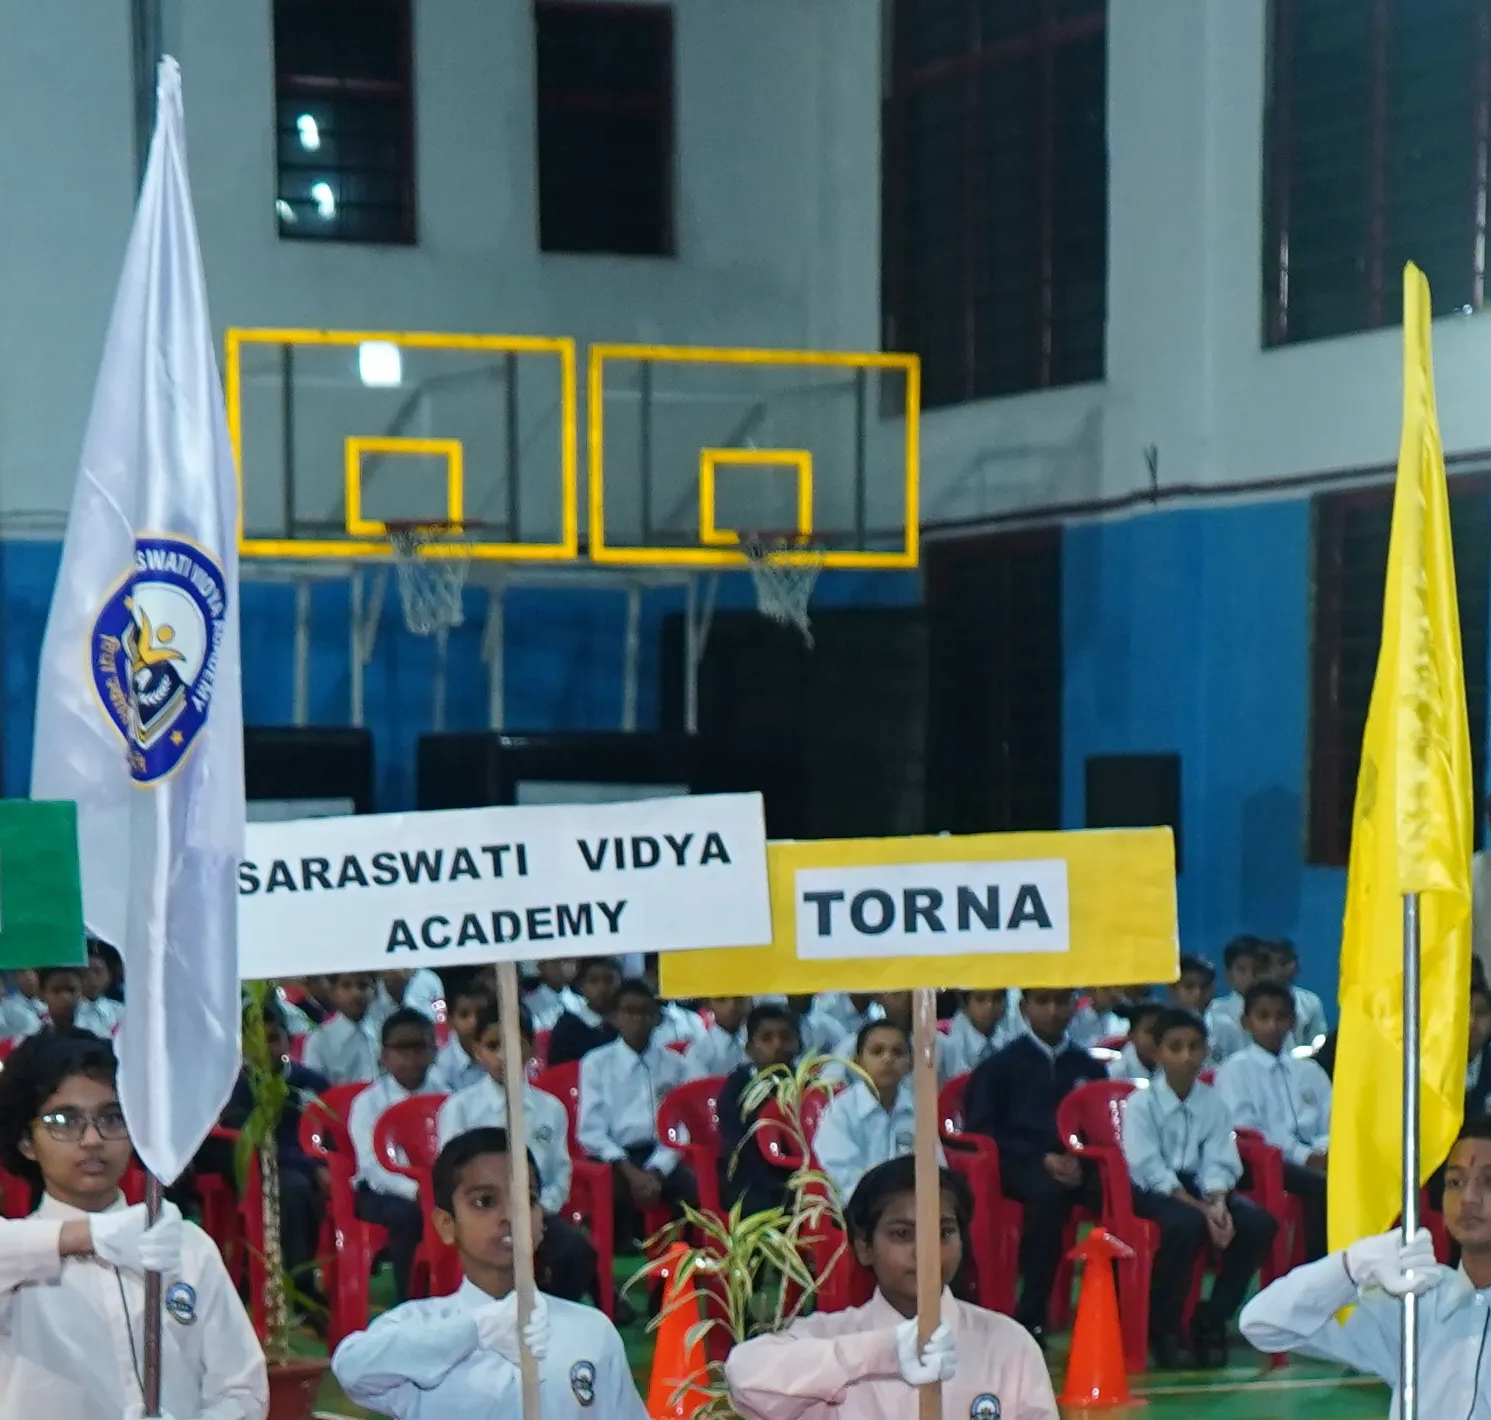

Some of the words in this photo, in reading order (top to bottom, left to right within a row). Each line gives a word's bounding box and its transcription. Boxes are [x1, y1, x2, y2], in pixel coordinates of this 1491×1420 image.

[237, 842, 528, 896] SARASWATI
[577, 831, 731, 872] VIDYA
[385, 899, 628, 954] ACADEMY
[803, 883, 1053, 937] TORNA
